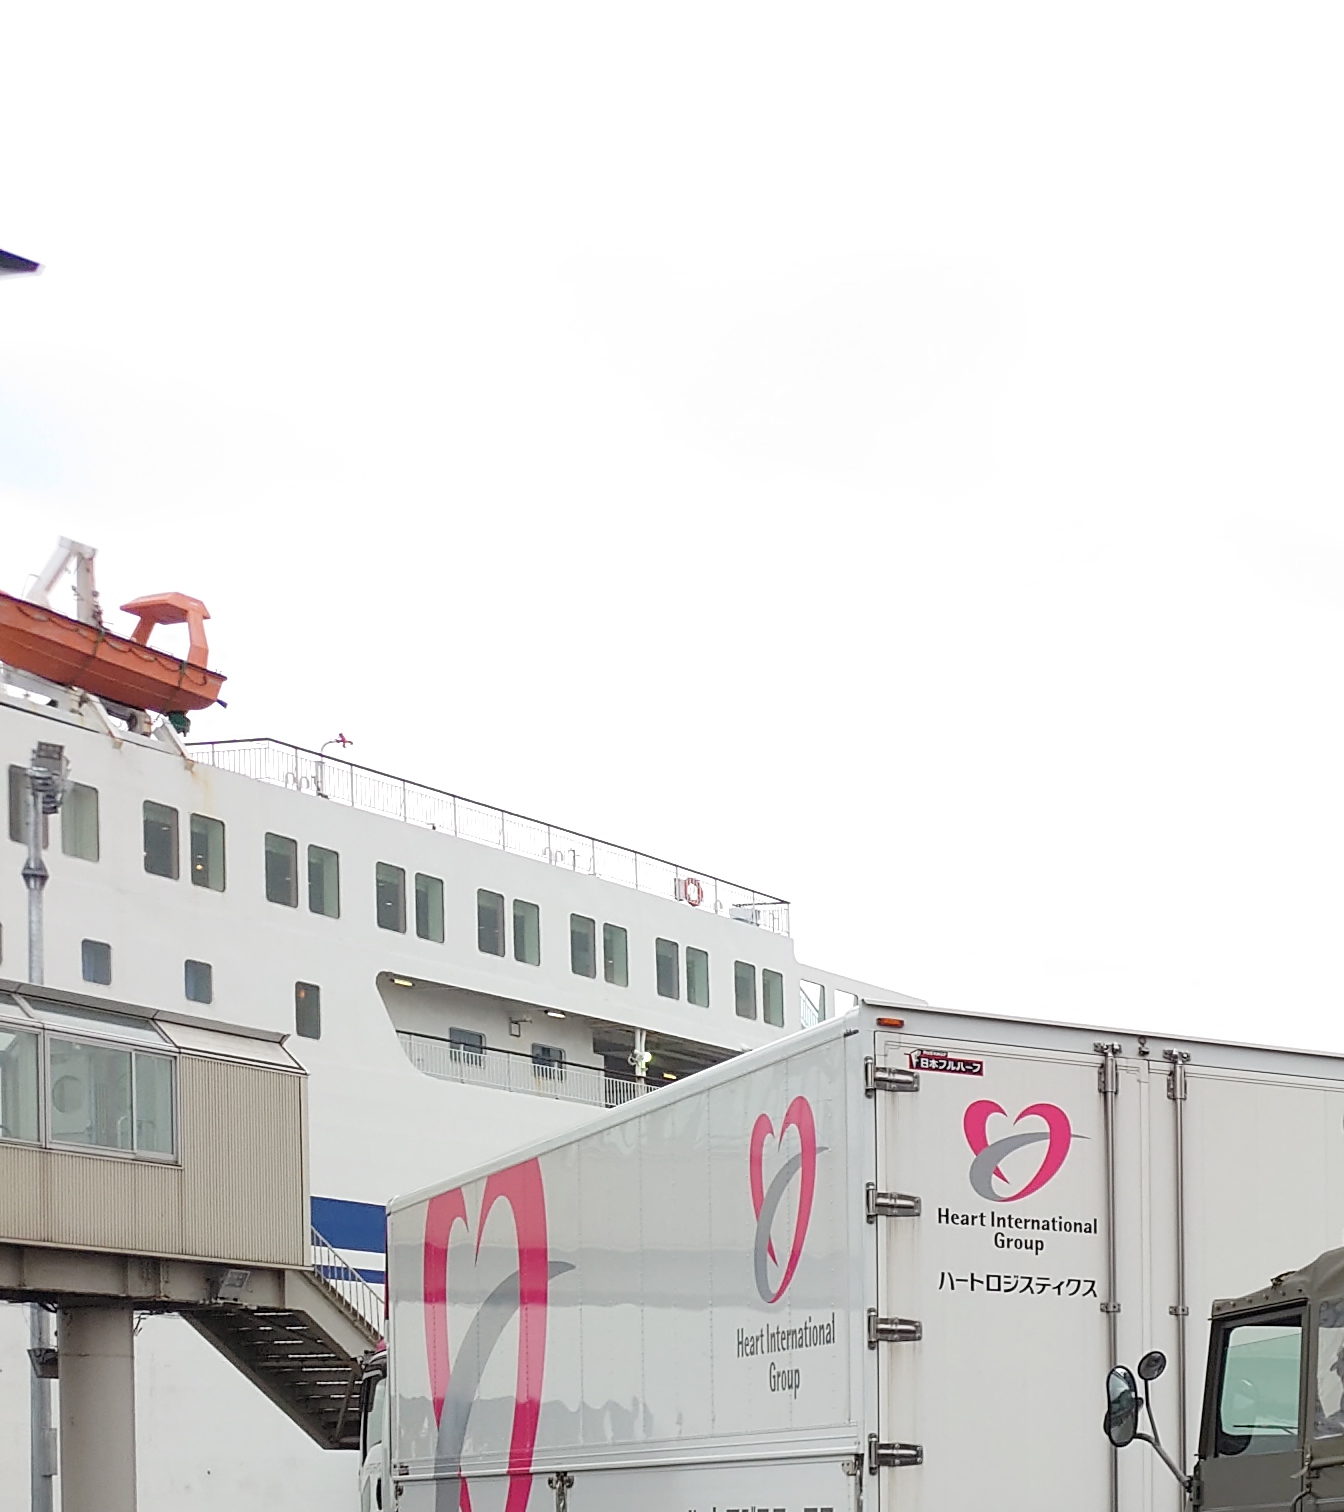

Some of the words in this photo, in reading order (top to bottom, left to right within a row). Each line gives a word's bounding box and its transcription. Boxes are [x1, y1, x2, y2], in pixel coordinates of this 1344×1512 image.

[920, 1057, 981, 1073] 日本フルハーフ
[937, 1207, 986, 1227] Heart
[991, 1211, 1098, 1235] International
[994, 1232, 1044, 1256] Group
[938, 1271, 1098, 1298] ハートロジスティクス
[736, 1327, 764, 1359] Heart
[766, 1311, 836, 1354] International
[769, 1361, 801, 1400] Group
